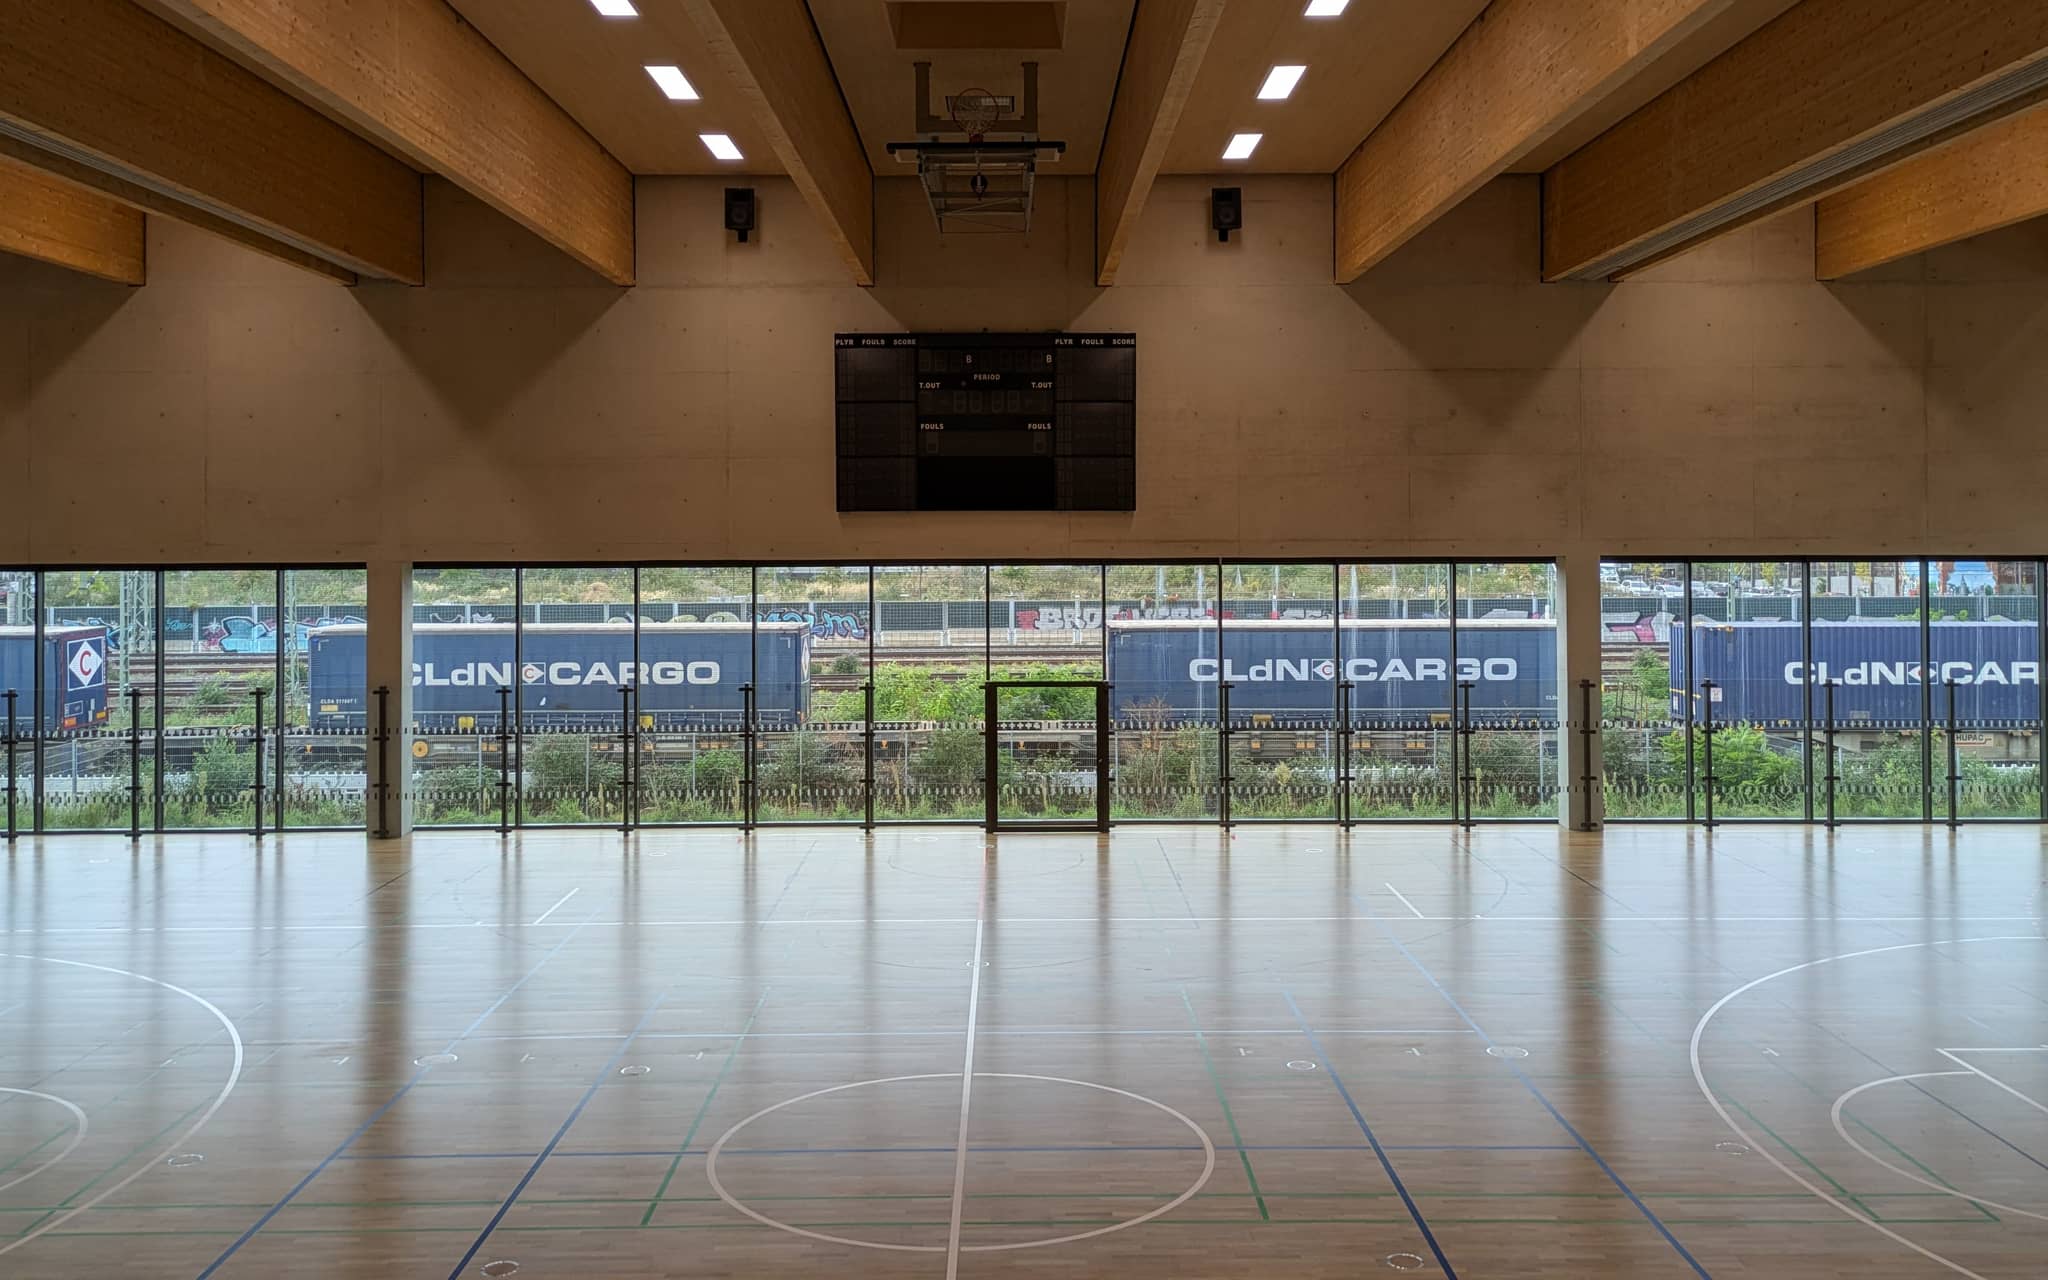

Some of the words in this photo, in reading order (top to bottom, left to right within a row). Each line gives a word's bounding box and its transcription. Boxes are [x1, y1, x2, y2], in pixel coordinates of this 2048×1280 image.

[861, 338, 885, 346] FOULS
[893, 338, 917, 346] SCORE
[973, 373, 1001, 381] PERIOD
[1031, 381, 1053, 389] T.OUT
[79, 650, 91, 676] C
[1189, 659, 1309, 682] CLdN
[1345, 658, 1518, 682] CARGO
[547, 661, 721, 686] CARGO
[1784, 661, 1906, 686] CLdN
[1956, 733, 1985, 742] HUPAC
